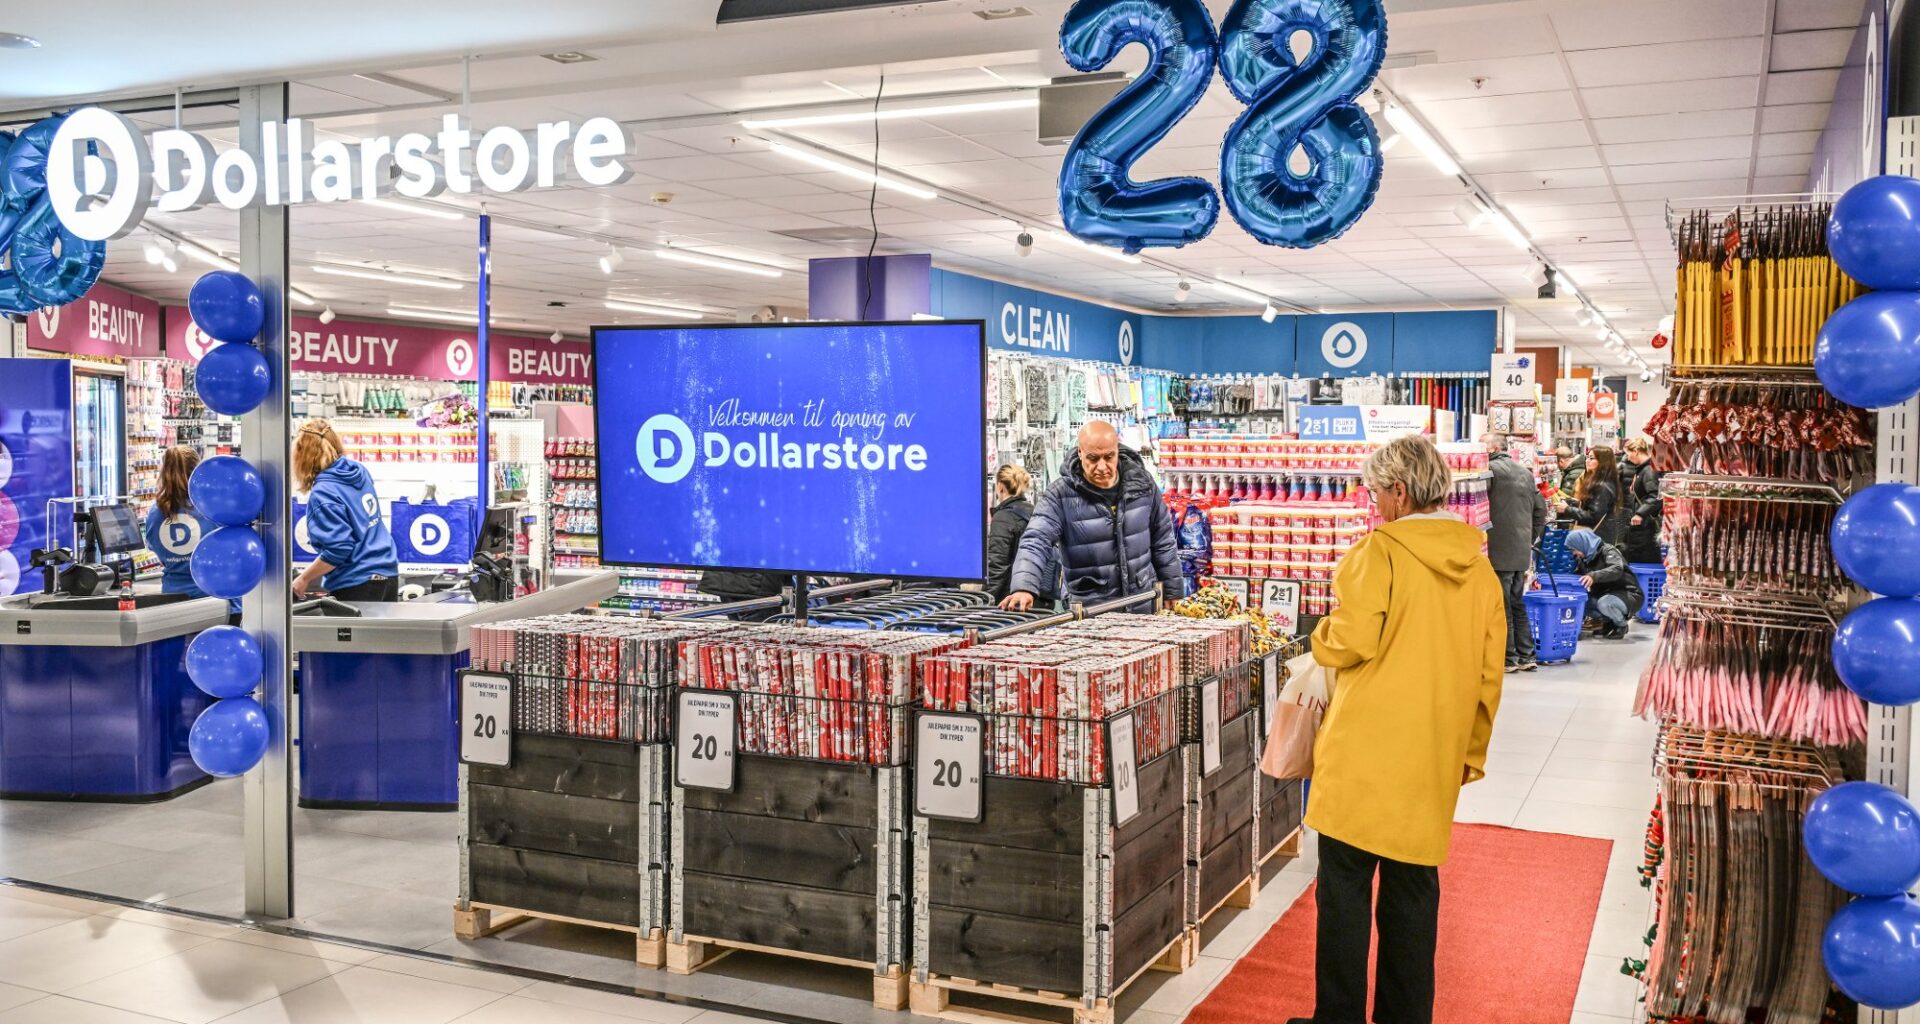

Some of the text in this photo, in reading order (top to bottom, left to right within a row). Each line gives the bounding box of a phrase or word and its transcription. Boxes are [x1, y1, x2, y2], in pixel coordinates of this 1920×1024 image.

[1057, 0, 1387, 251] 28
[152, 113, 626, 212] Dollarstore
[88, 300, 144, 348] BEAUTY
[1001, 301, 1070, 352] CLEAN
[290, 331, 398, 367] BEAUTY
[508, 348, 592, 378] BEAUTY
[1567, 394, 1578, 403] 30
[709, 398, 917, 441] Velkommen til åpning av
[703, 431, 928, 471] Dollarstore
[1297, 692, 1330, 712] LIN
[473, 713, 496, 739] 20
[692, 733, 718, 761] 20
[932, 758, 962, 788] 20
[1118, 761, 1130, 791] 20
